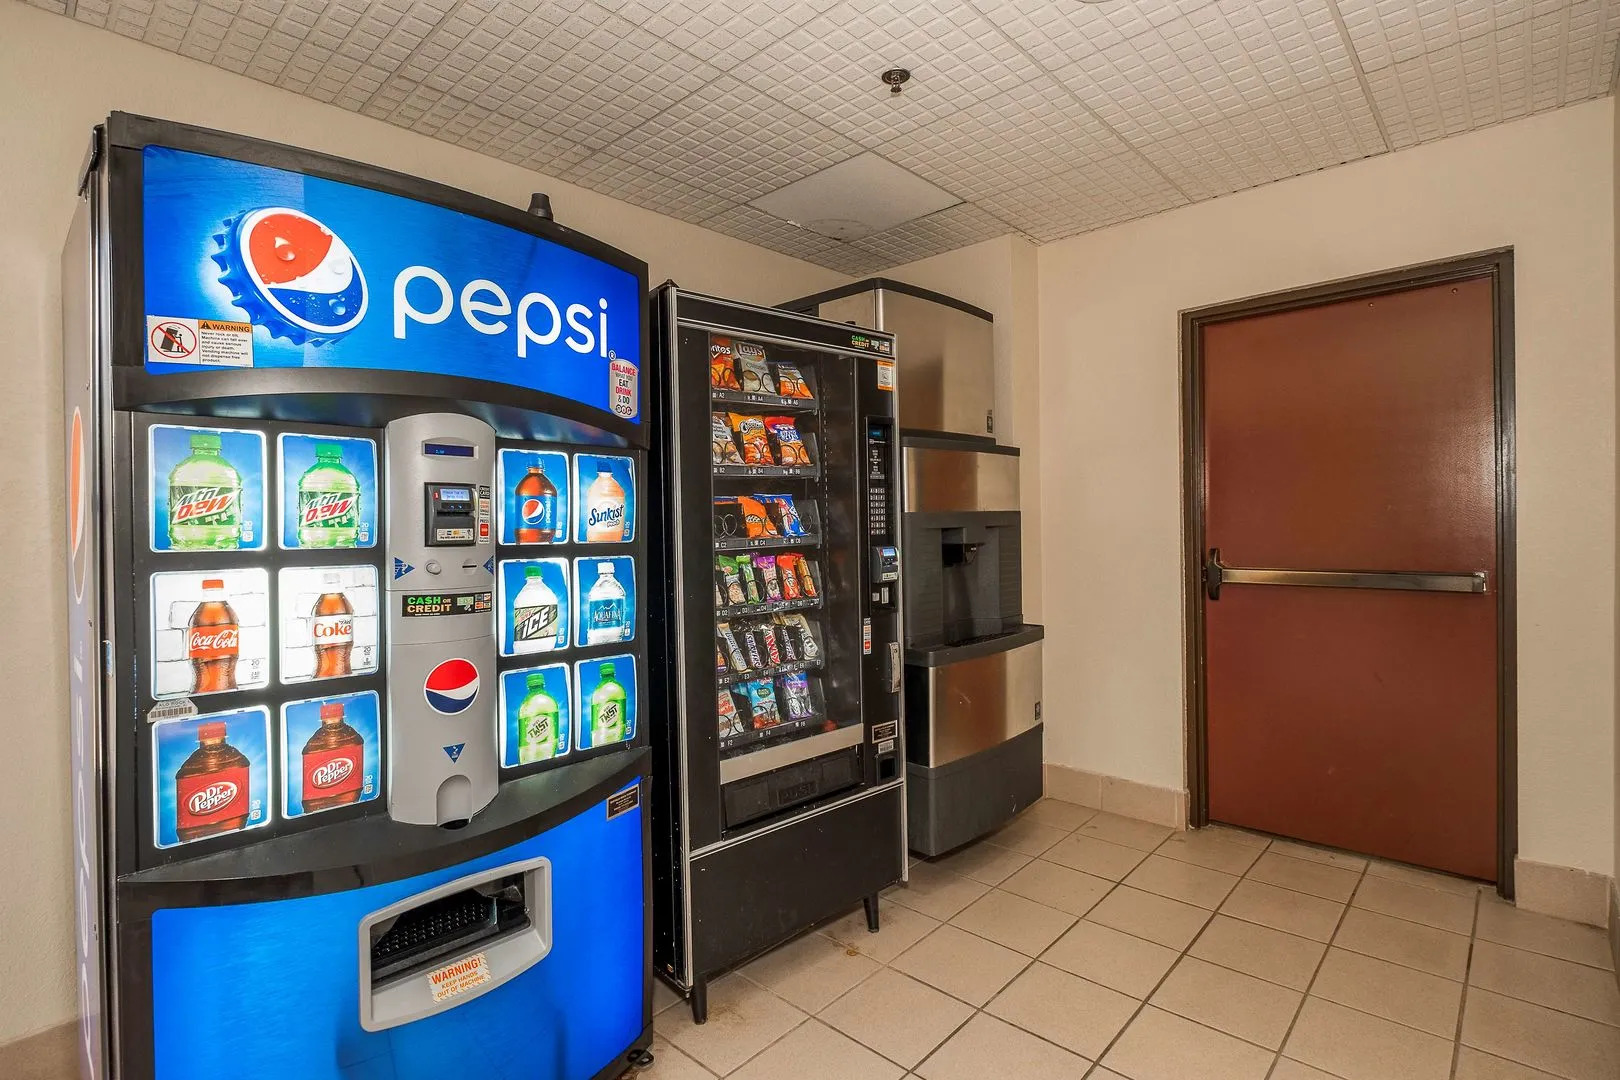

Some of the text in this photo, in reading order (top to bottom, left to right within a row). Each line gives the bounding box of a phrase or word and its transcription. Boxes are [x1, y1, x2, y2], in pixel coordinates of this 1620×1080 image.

[394, 266, 607, 358] pepsi
[212, 324, 250, 333] WARNING
[611, 362, 636, 377] BALANCE
[615, 386, 632, 397] DRINK
[588, 504, 625, 527] Sunkist
[407, 596, 441, 605] CASH
[407, 604, 452, 613] CREDIT
[313, 621, 352, 638] Coke
[522, 606, 550, 639] ICE
[316, 764, 352, 785] Pepper
[328, 760, 342, 774] Dr
[205, 785, 223, 799] Dr
[193, 789, 234, 813] Pepper
[431, 957, 482, 984] WARNING!
[437, 975, 485, 998] OUT OF MACHINE
[441, 971, 478, 989] KEEP HANDS
